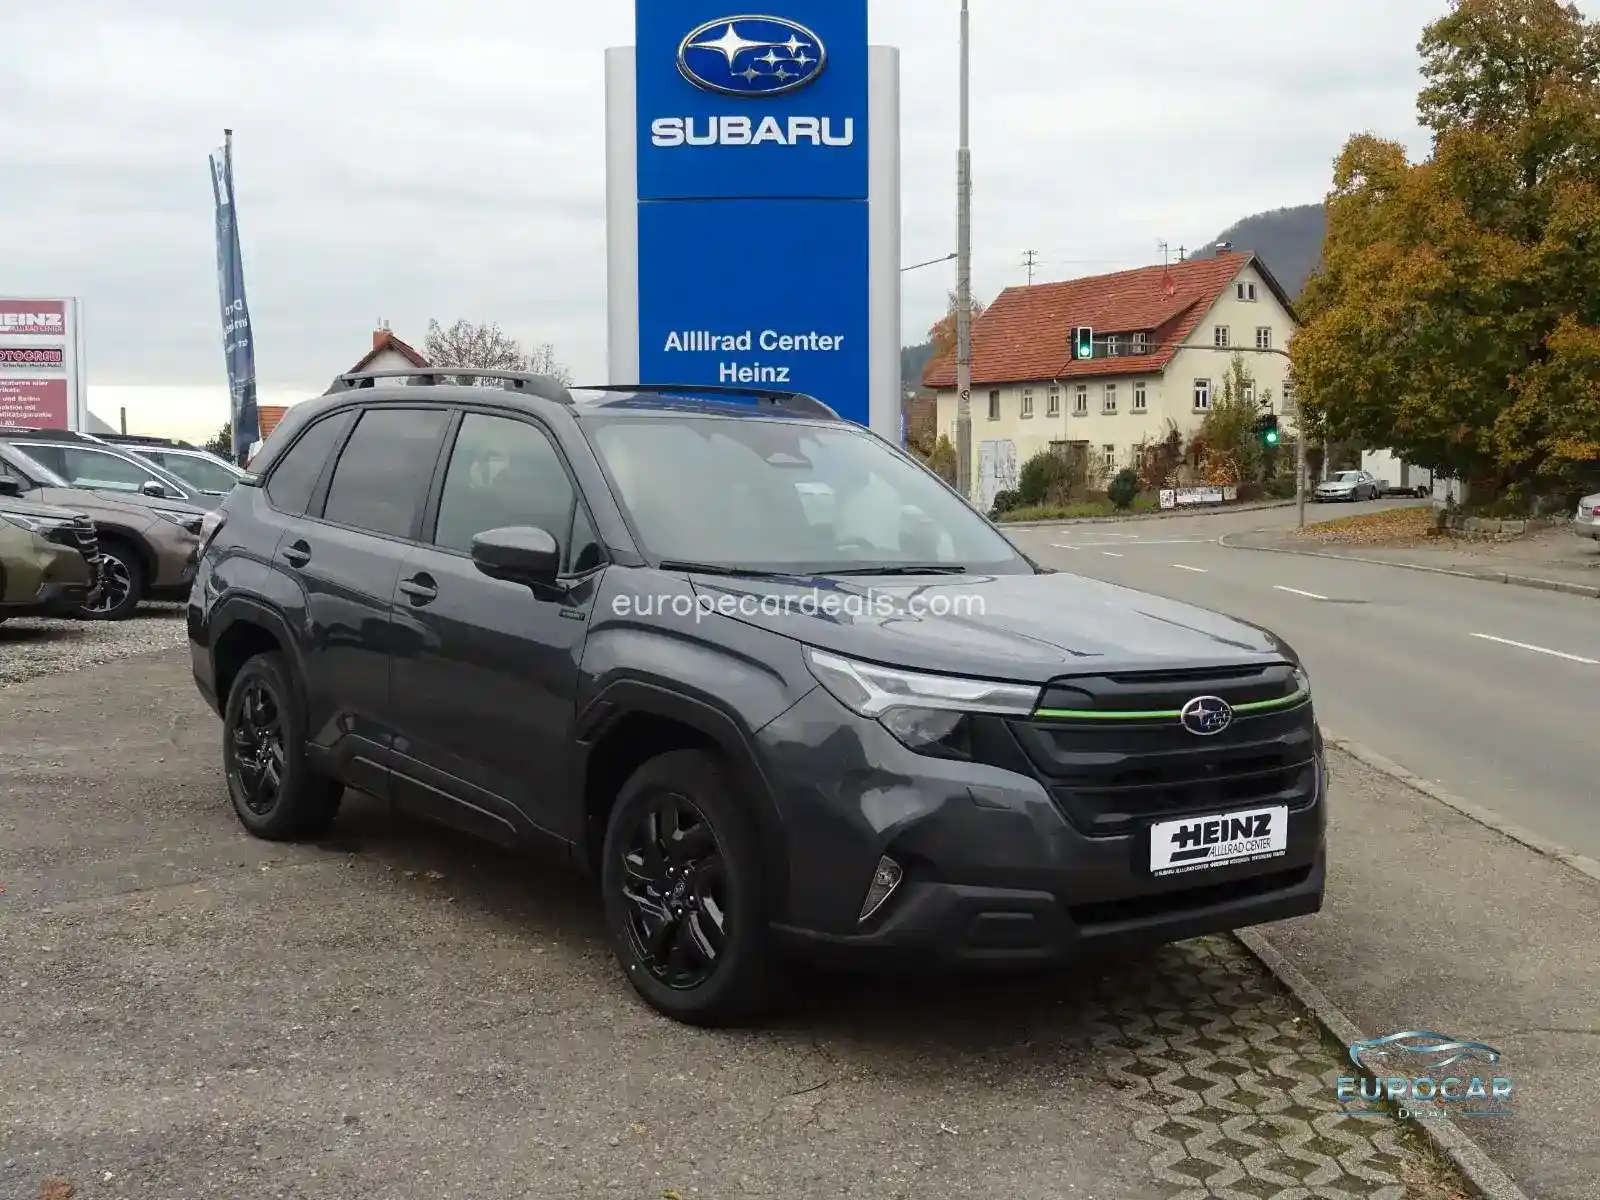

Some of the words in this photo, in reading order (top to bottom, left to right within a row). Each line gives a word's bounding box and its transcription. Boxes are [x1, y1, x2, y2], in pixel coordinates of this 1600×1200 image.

[651, 117, 853, 146] SUBARU
[664, 331, 750, 351] Allllrad
[759, 330, 844, 351] Center
[719, 362, 790, 382] Heinz
[1171, 814, 1271, 848] HEINZ
[1245, 837, 1272, 852] CENTER
